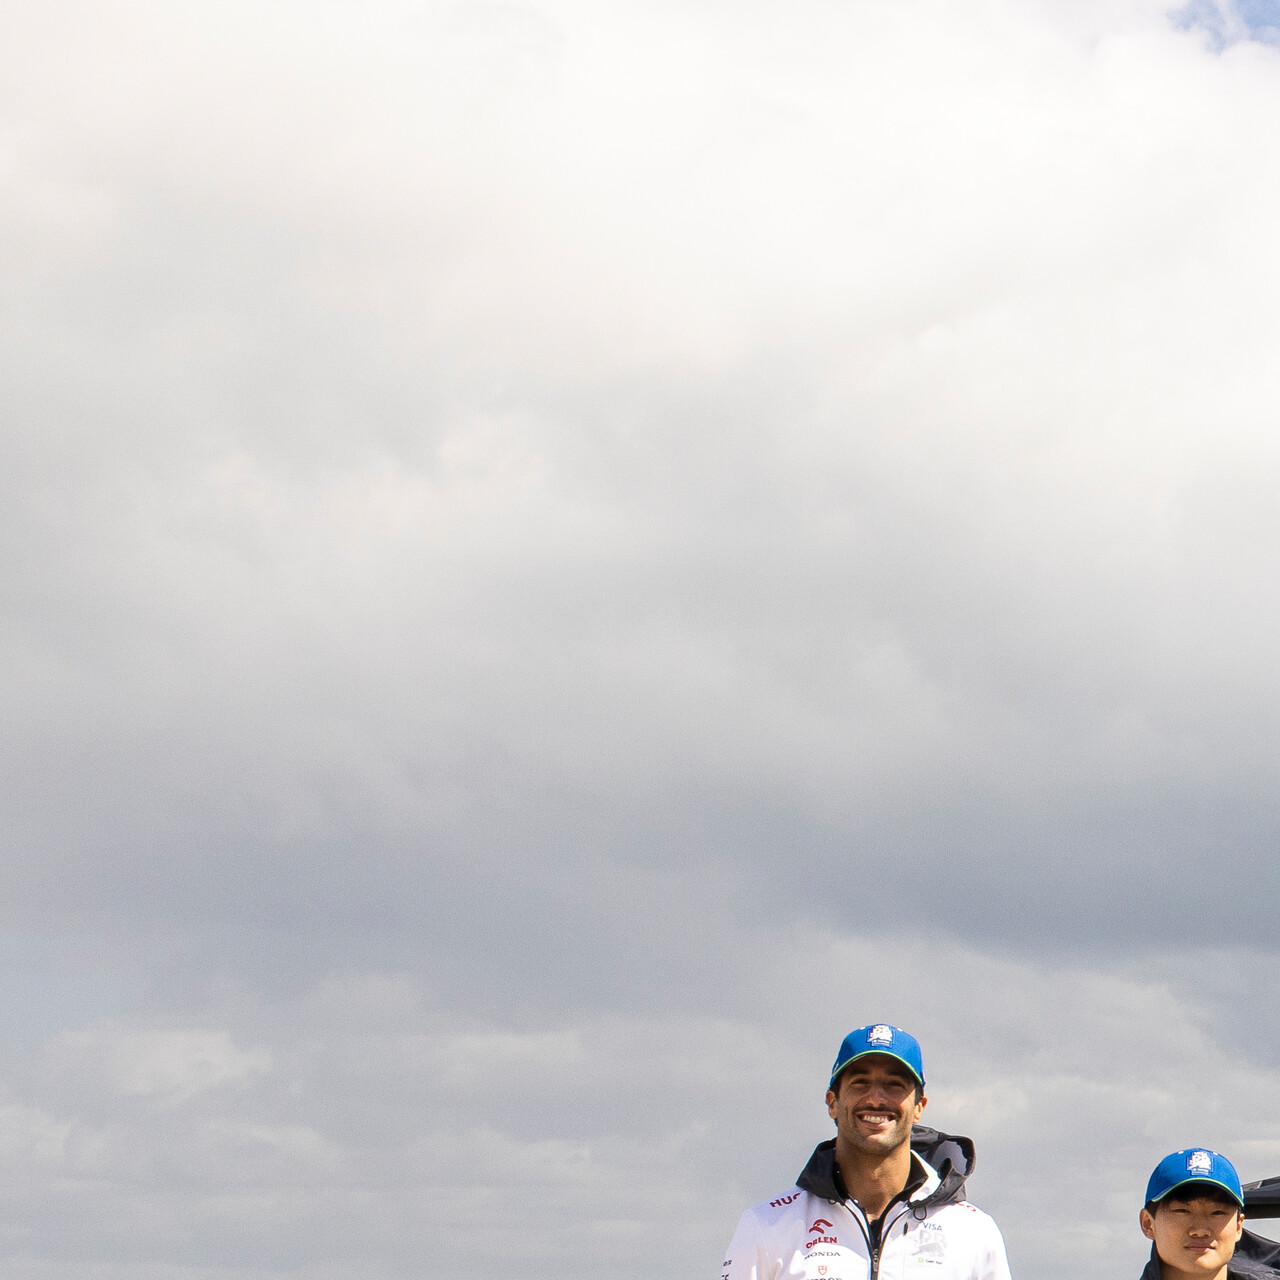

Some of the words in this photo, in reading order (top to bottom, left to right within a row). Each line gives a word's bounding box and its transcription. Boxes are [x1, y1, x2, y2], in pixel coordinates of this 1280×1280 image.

[923, 1222, 943, 1232] VISA
[806, 1236, 838, 1249] ORLEN
[804, 1251, 841, 1260] HONDA
